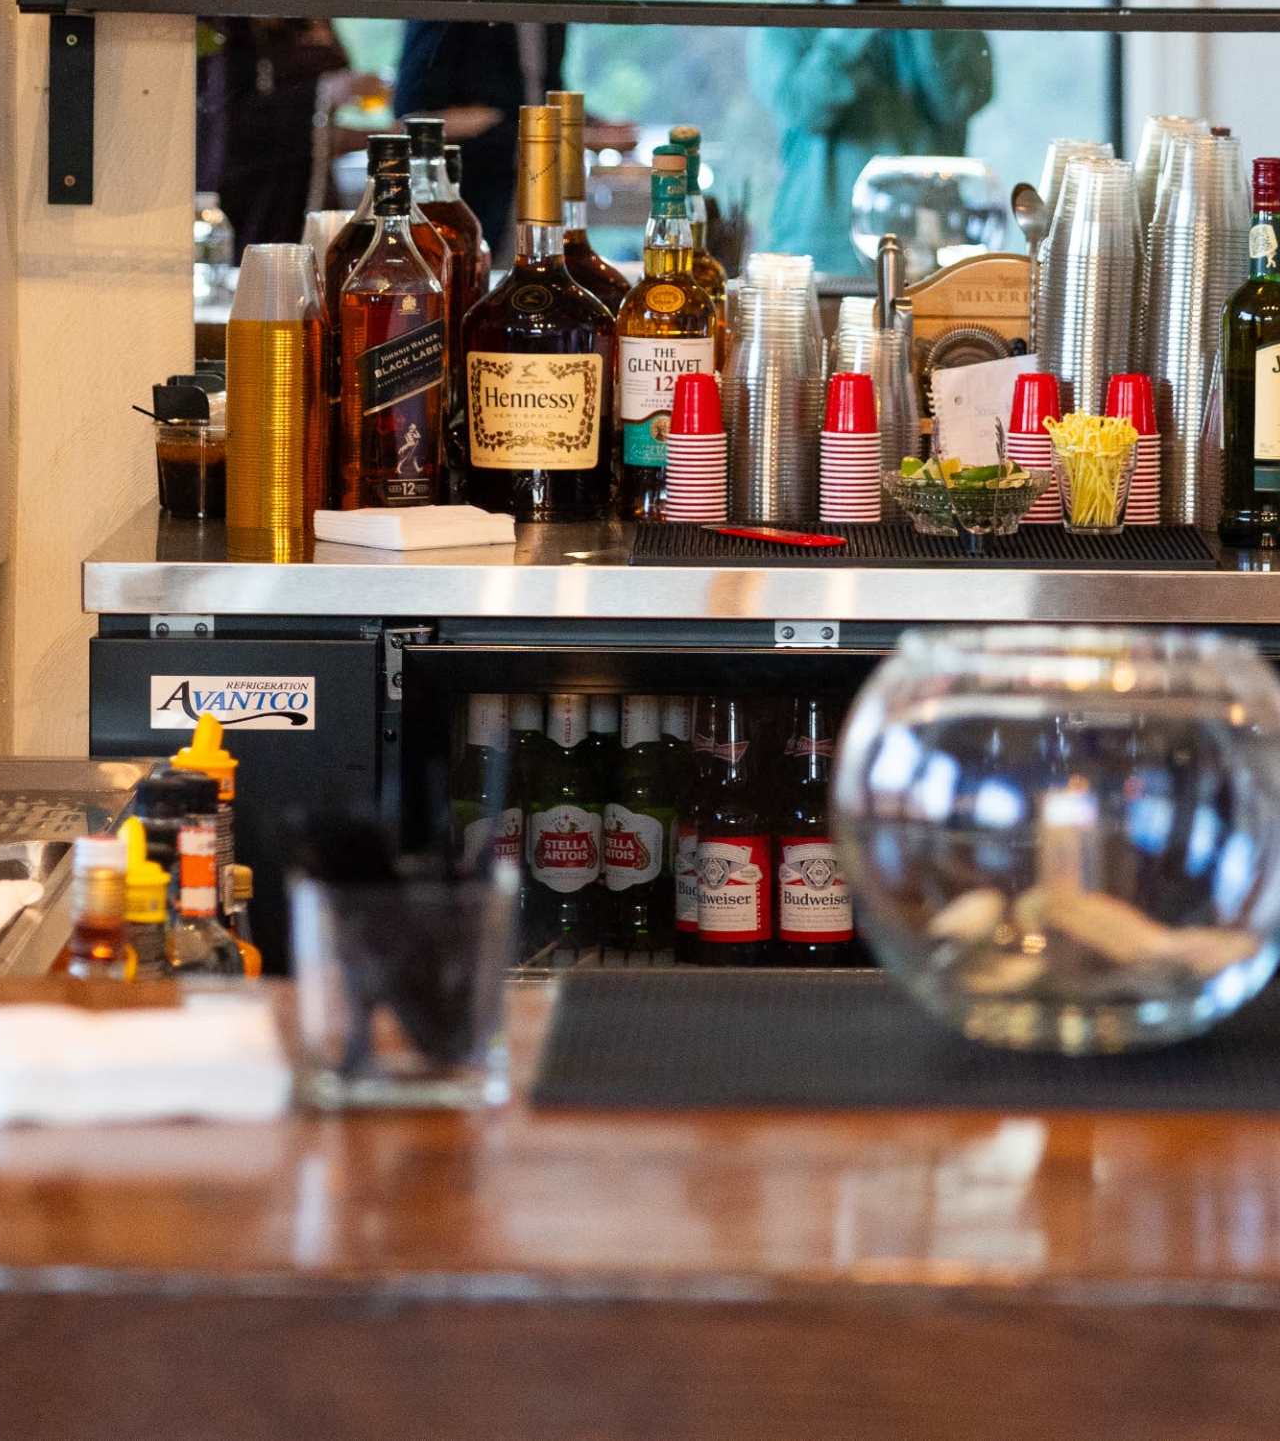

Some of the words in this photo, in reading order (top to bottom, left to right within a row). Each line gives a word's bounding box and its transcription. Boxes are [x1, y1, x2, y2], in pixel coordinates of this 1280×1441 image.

[654, 348, 677, 358] THE
[374, 357, 410, 379] BLACK
[627, 358, 702, 374] GLENLIVET
[655, 376, 674, 392] 12
[485, 387, 579, 414] Hennessy
[402, 482, 417, 496] 12
[225, 681, 309, 690] REFRIGERATION
[157, 680, 309, 716] AVANTCO
[544, 839, 588, 849] STELLA
[607, 839, 635, 849] ELLA
[543, 850, 589, 861] ARTOIS
[606, 850, 636, 861] RTOIS
[699, 893, 752, 905] dweiser
